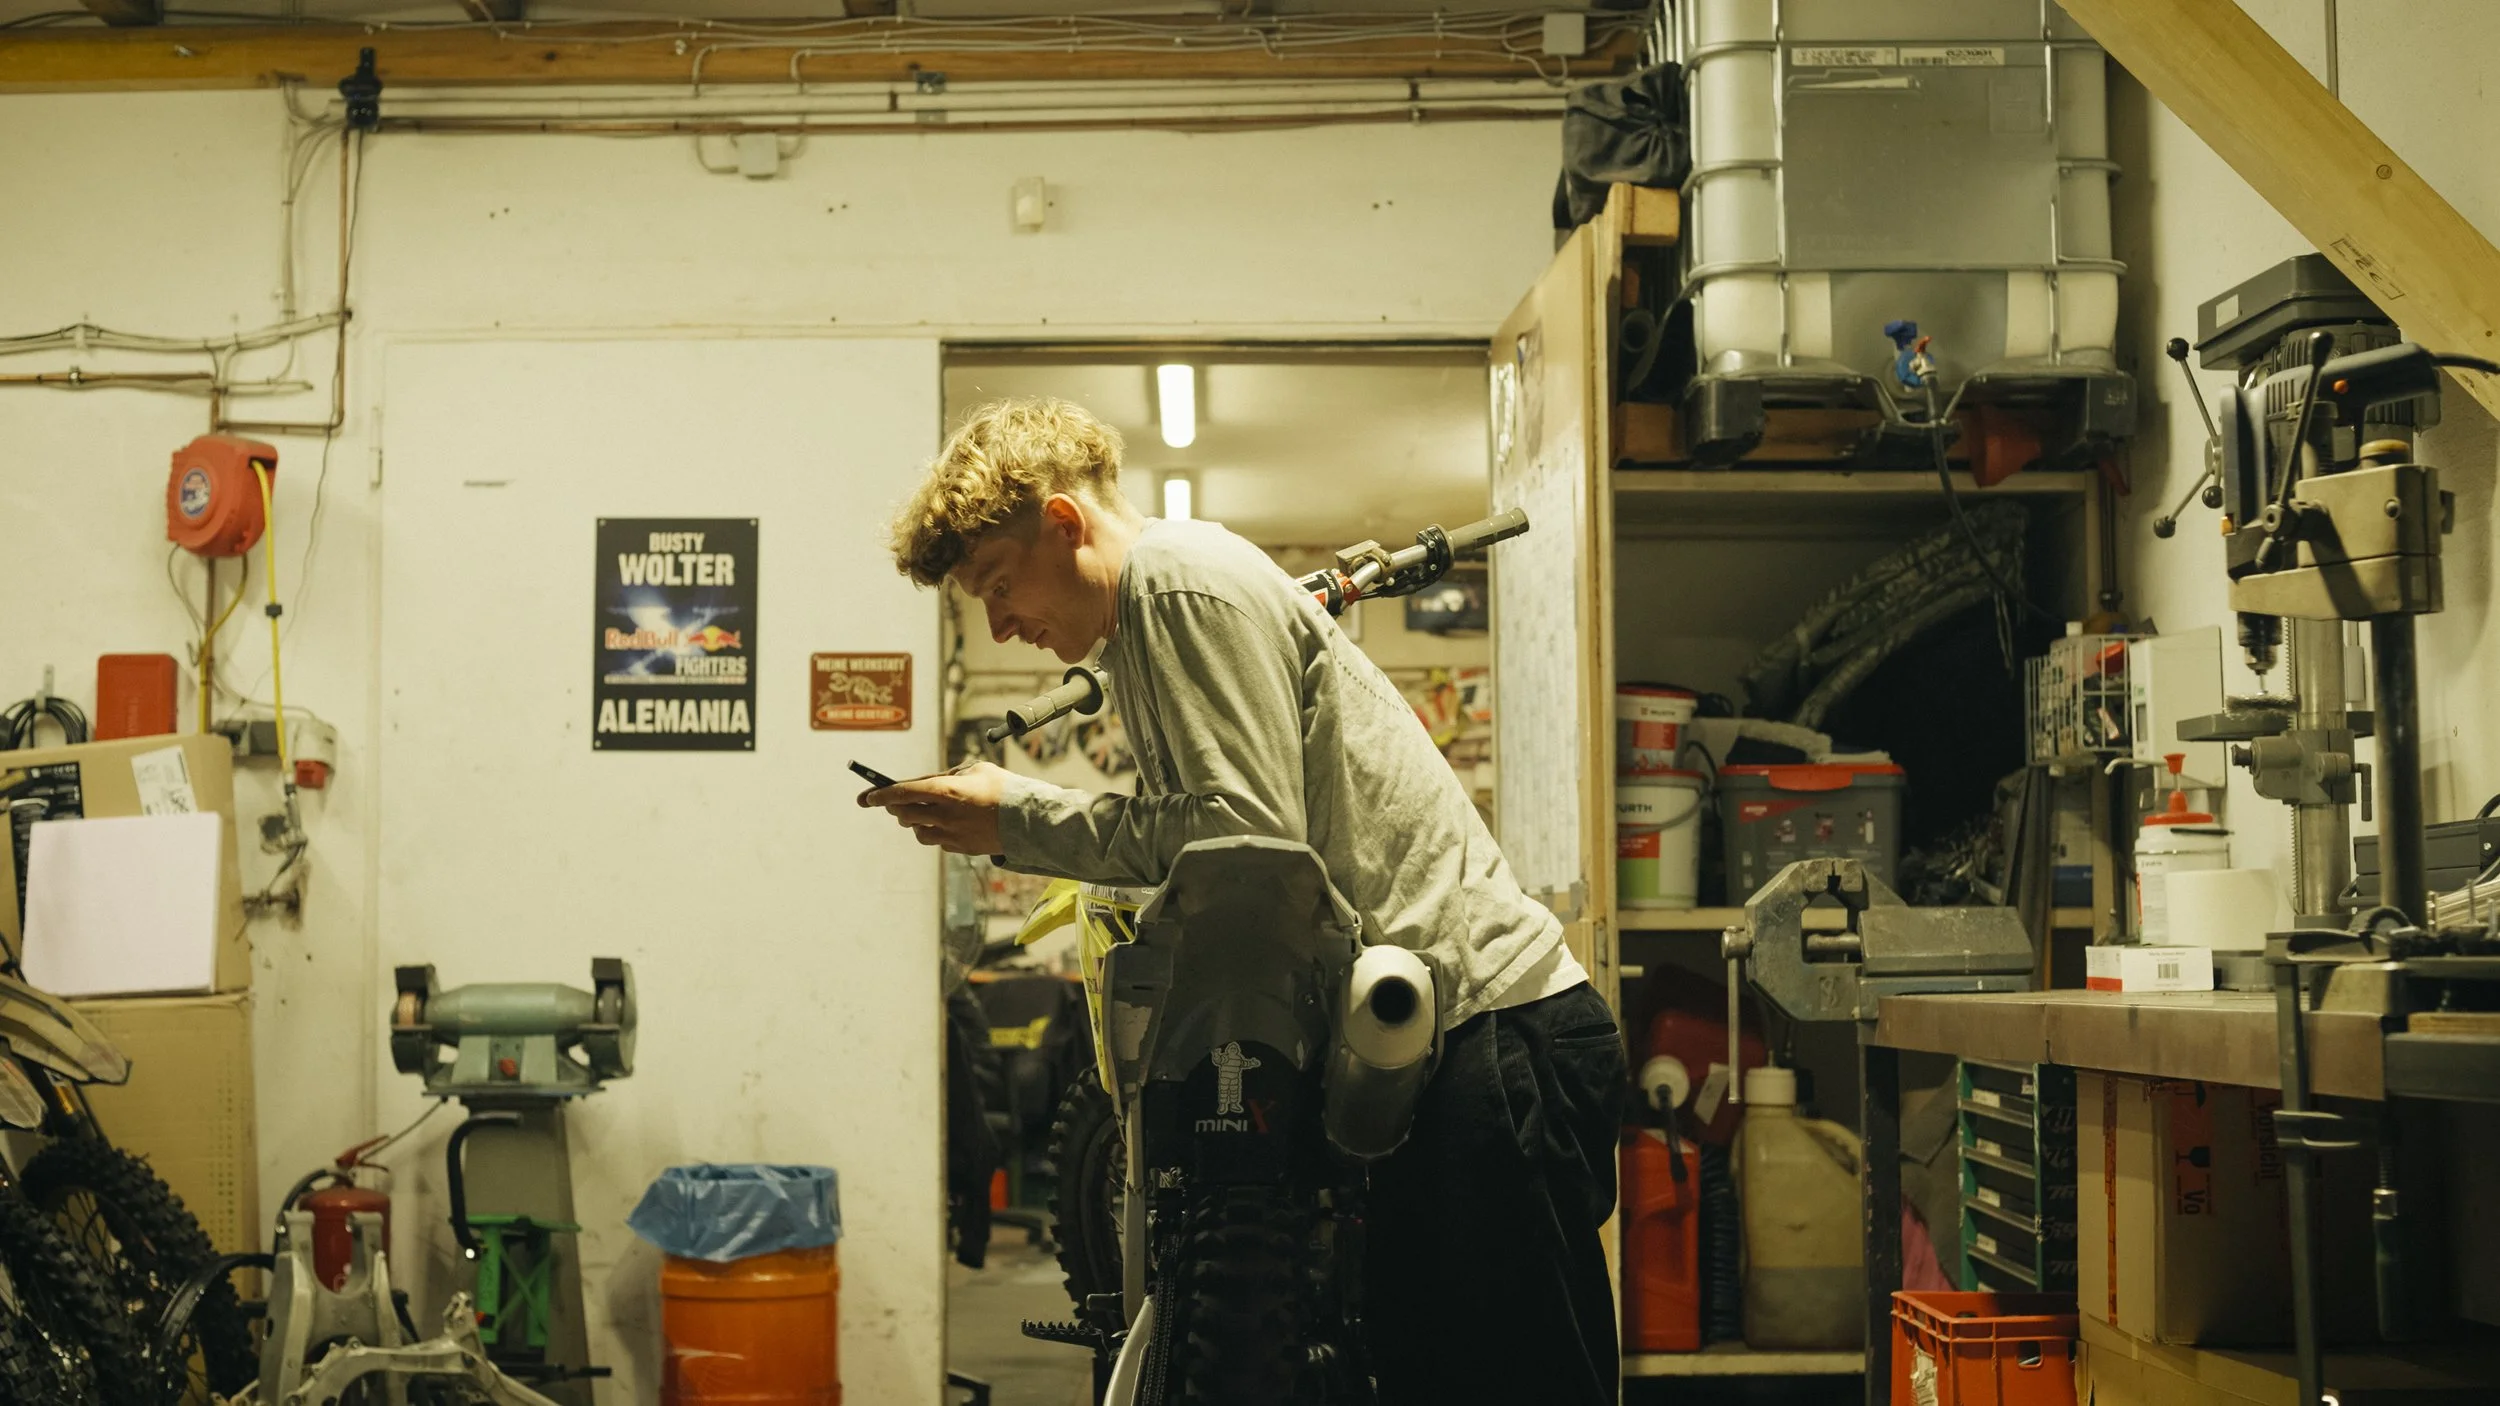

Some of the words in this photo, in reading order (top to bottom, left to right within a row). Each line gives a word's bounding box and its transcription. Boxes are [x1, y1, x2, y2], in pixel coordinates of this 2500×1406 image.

[649, 532, 704, 552] BUSTY
[618, 553, 735, 586] WOLTER
[675, 656, 747, 676] FIGHTERS
[817, 658, 847, 672] MEINE
[597, 699, 751, 733] ALEMANIA
